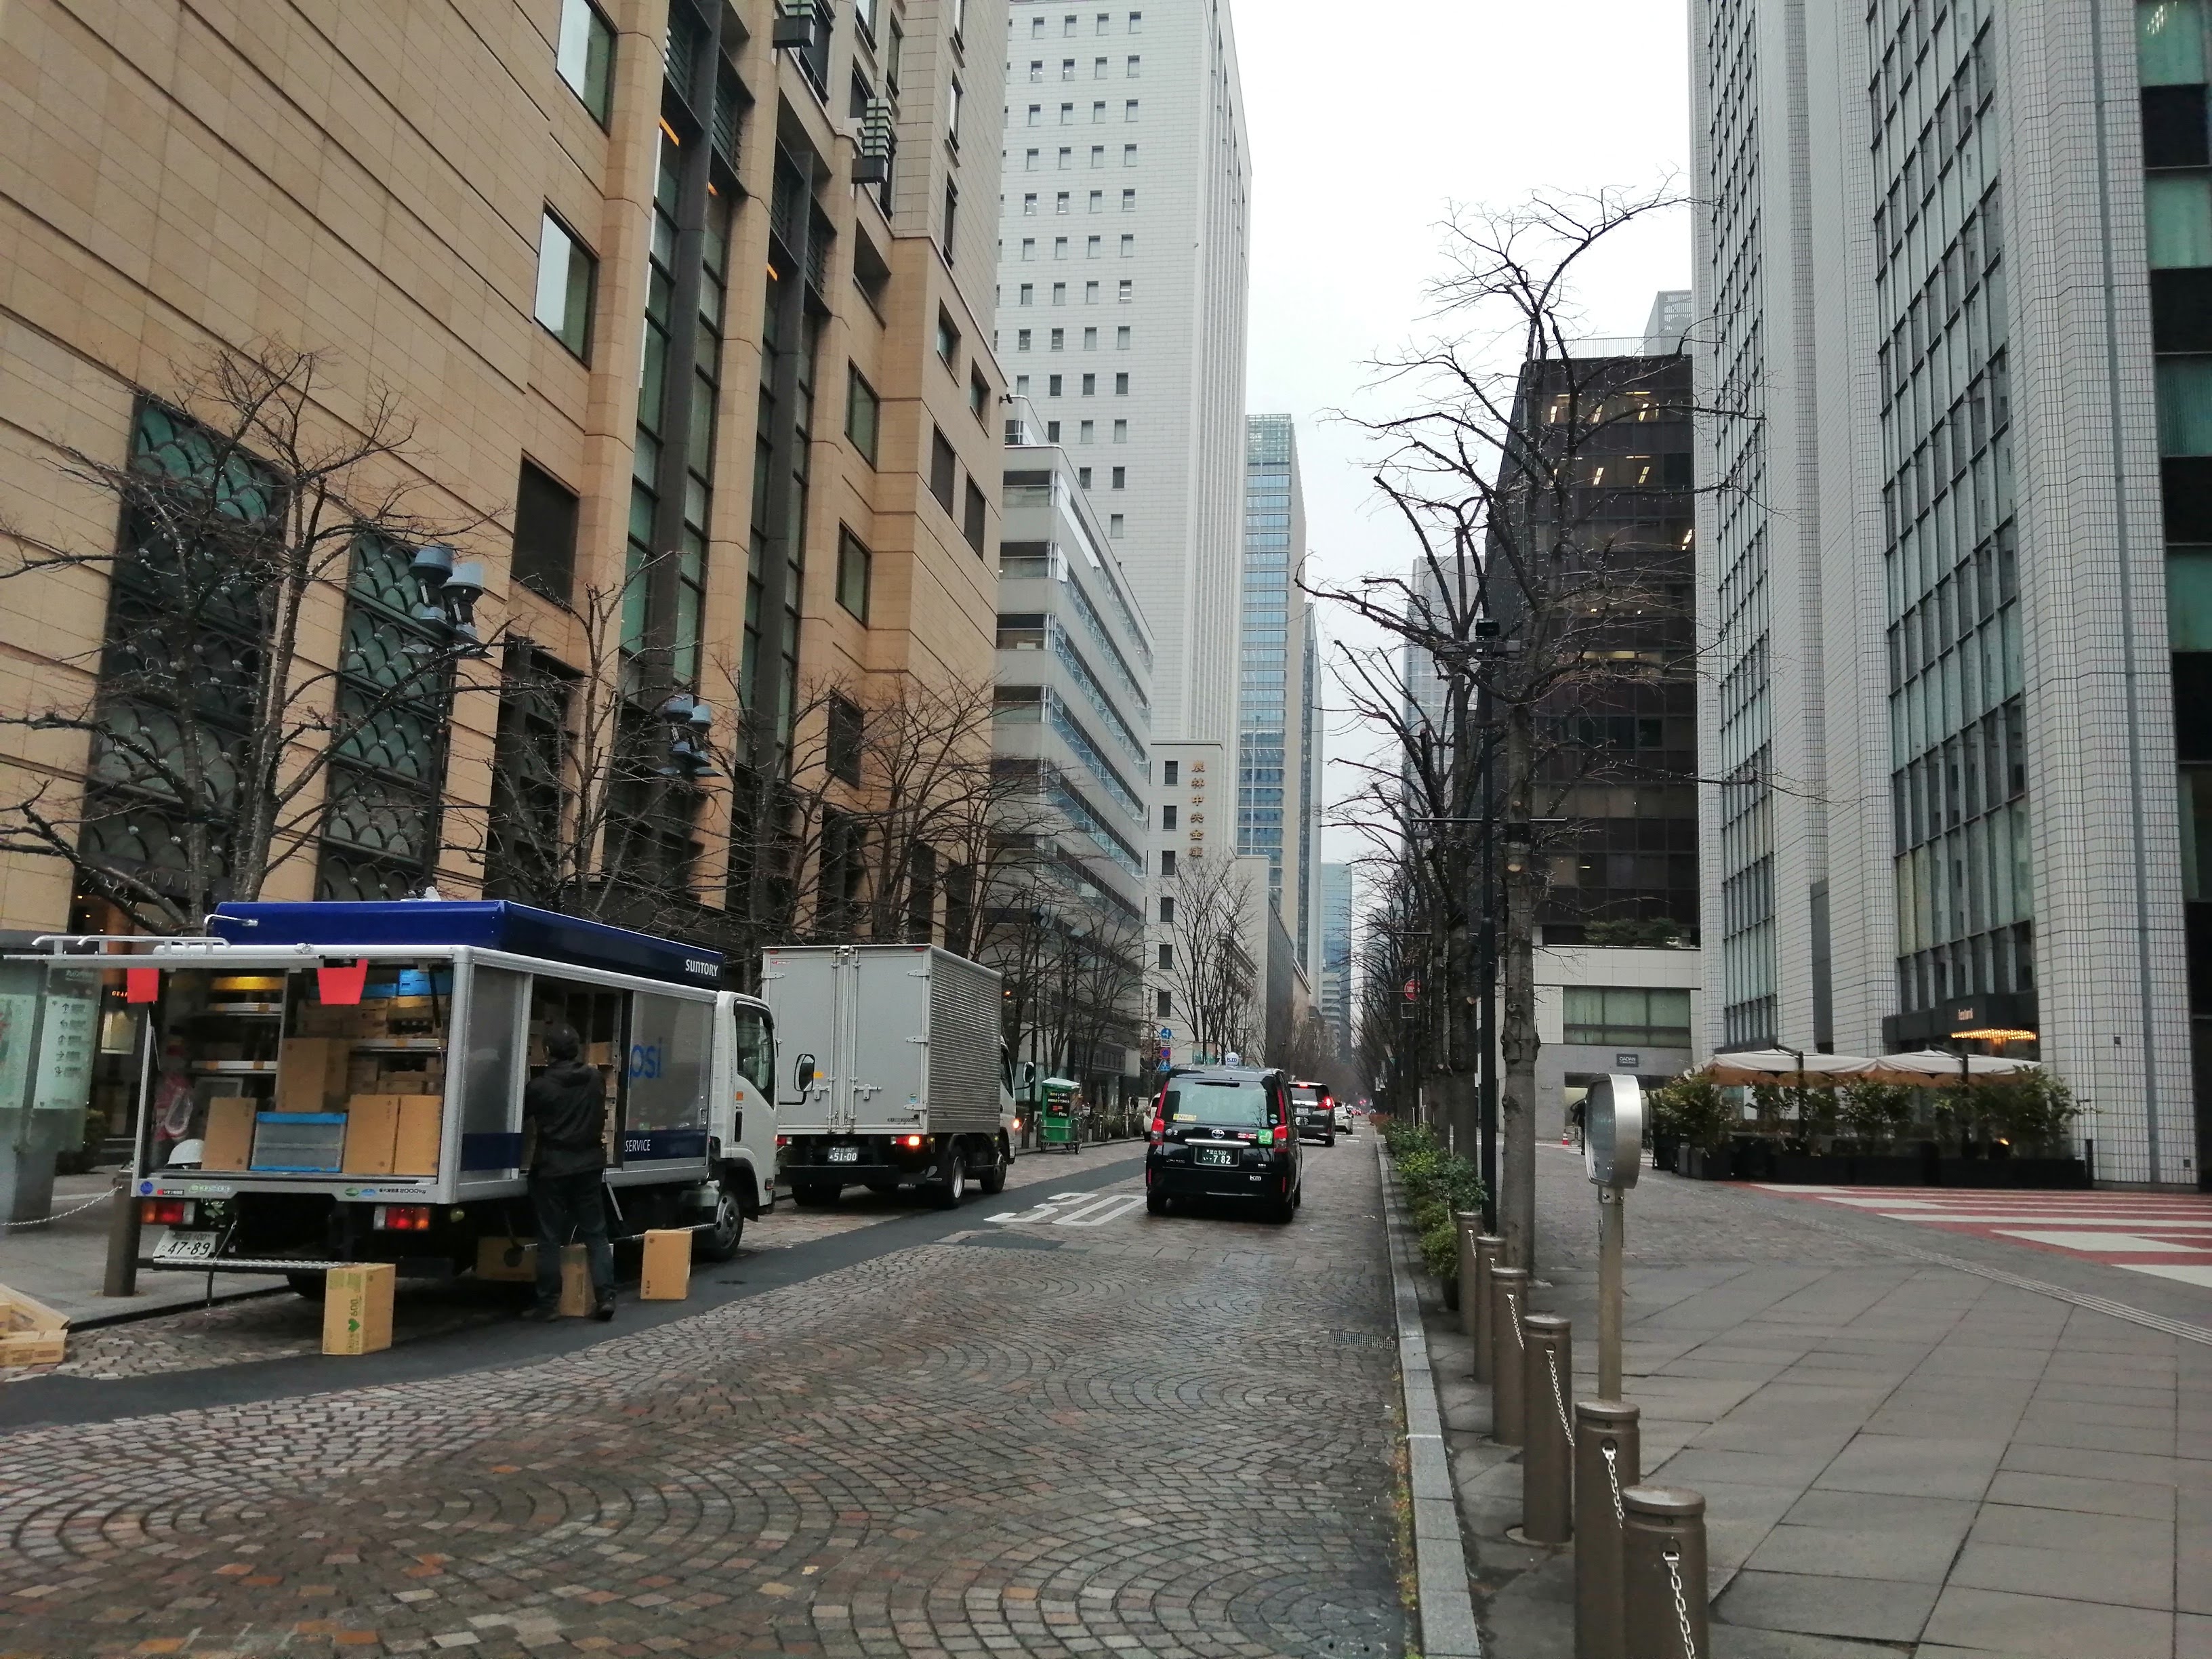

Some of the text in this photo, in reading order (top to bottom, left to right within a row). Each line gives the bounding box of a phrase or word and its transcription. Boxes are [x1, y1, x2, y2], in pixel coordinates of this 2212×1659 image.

[1189, 760, 1206, 859] 農林中央金庫
[625, 1139, 651, 1152] SERVICE
[834, 1152, 857, 1161] 51-00
[983, 1192, 1147, 1226] 30
[167, 1242, 211, 1255] 47-89
